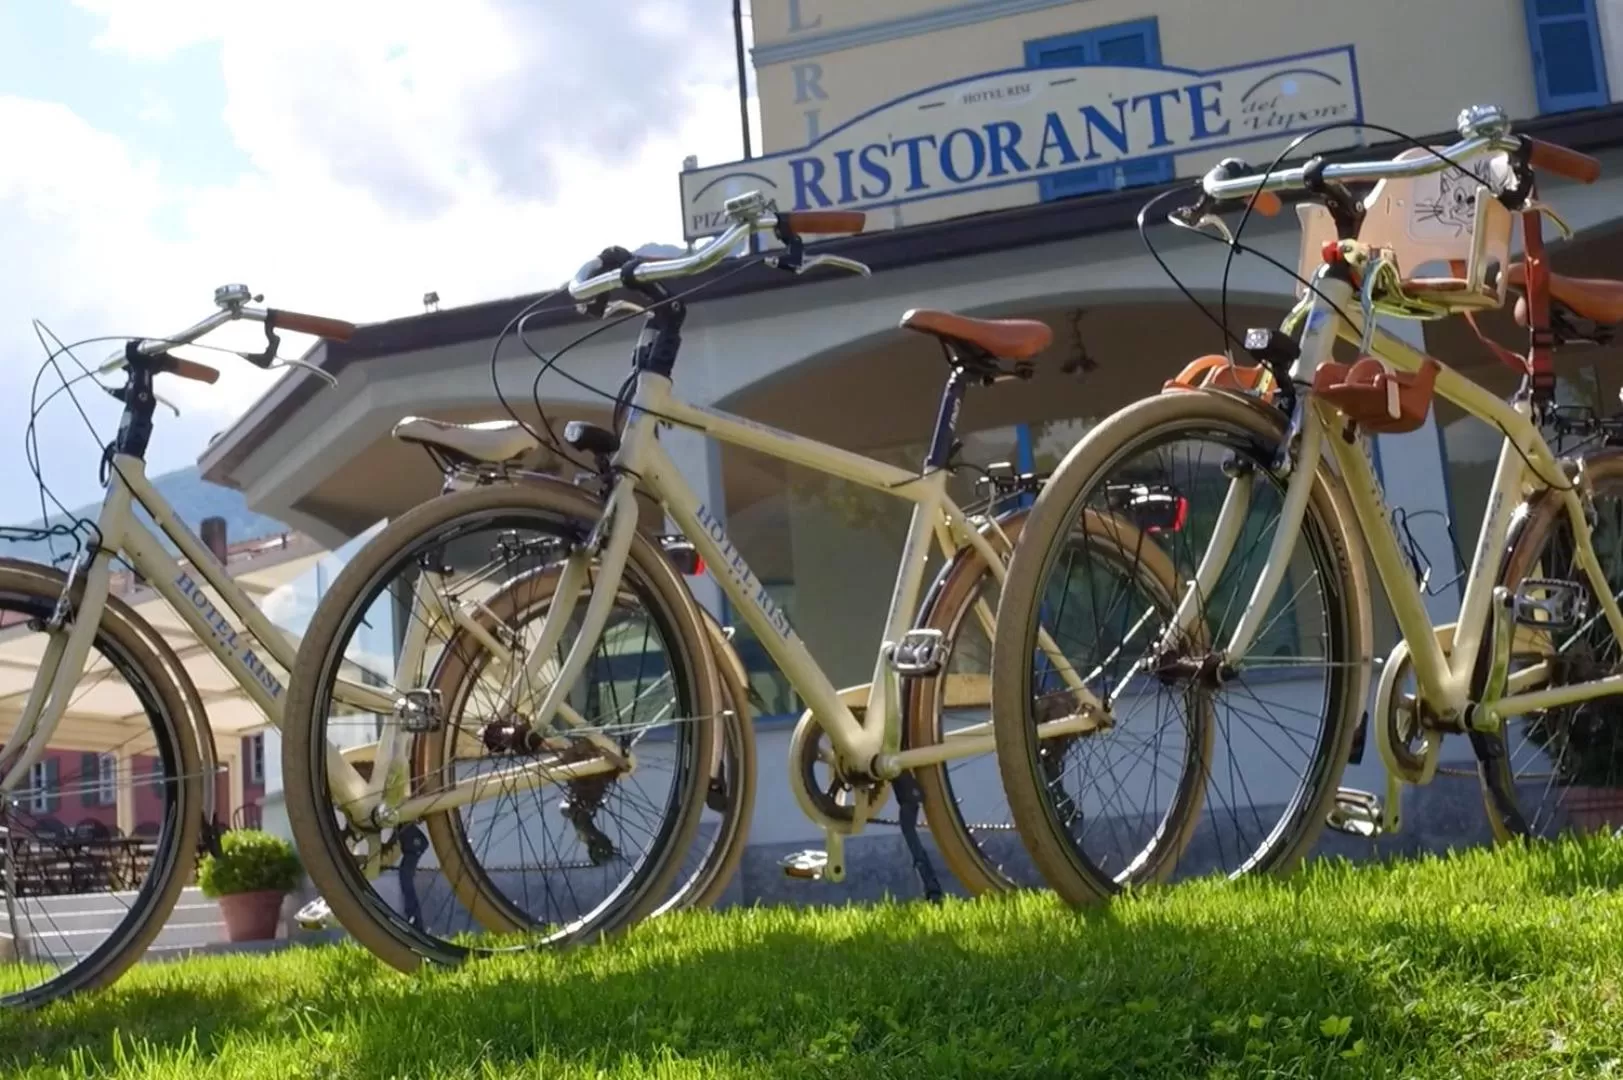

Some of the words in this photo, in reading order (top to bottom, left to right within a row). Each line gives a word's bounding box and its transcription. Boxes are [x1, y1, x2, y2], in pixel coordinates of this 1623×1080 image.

[787, 80, 1231, 211] RISTORANTE
[962, 88, 1004, 105] HOTEL
[175, 572, 239, 650] HOTEL
[242, 649, 284, 697] RISI
[695, 503, 753, 587] HOTEL
[757, 589, 793, 639] RISI
